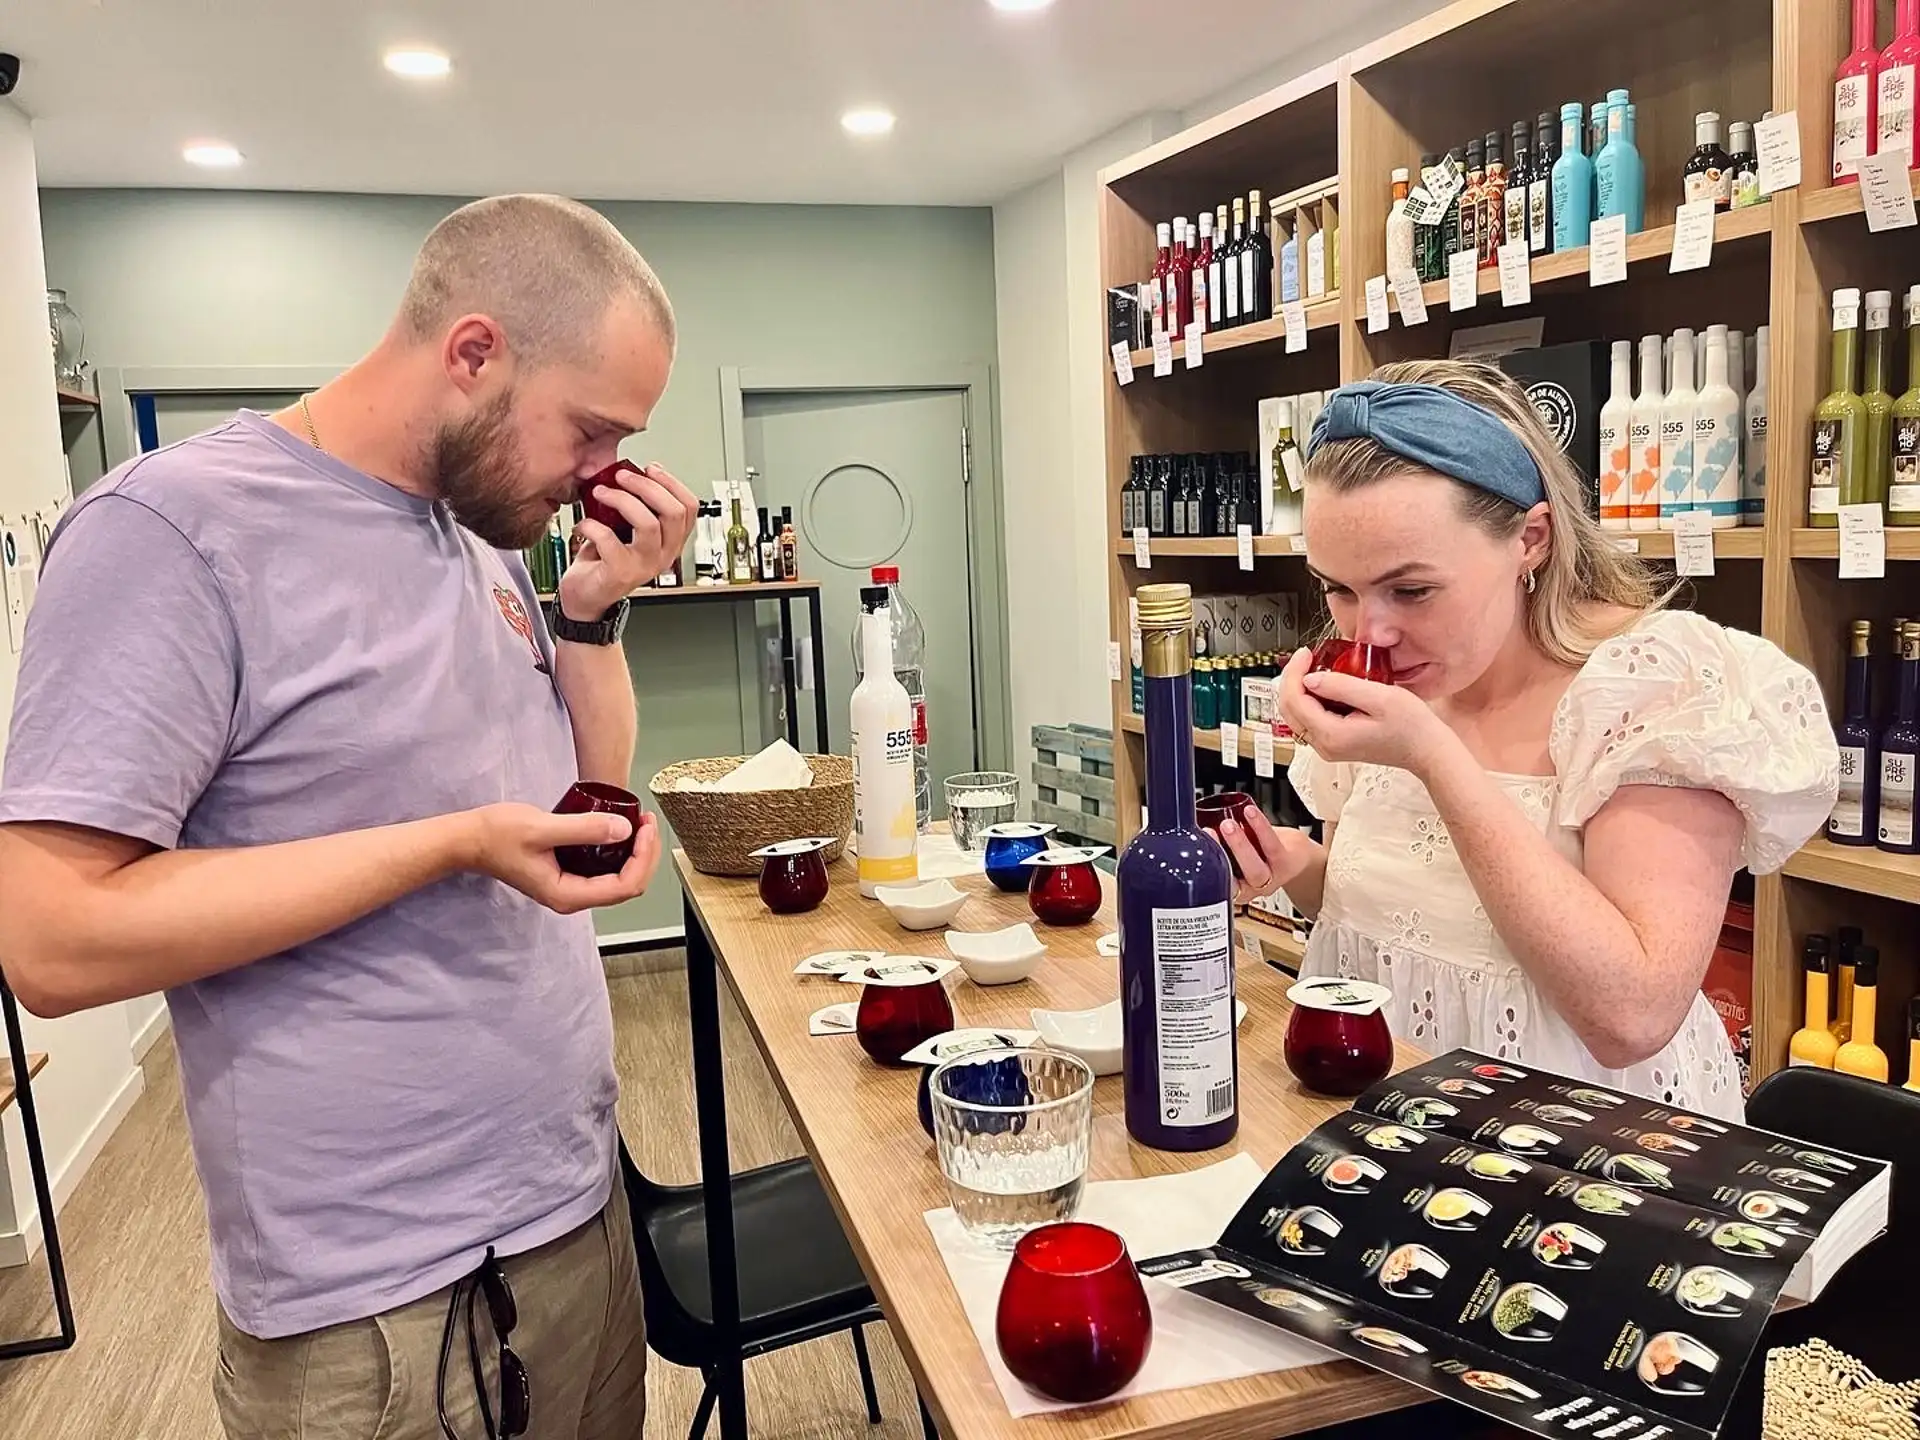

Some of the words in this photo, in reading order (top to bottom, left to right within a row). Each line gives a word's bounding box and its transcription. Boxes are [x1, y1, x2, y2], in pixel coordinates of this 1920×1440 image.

[1886, 75, 1901, 85] SU
[1840, 82, 1856, 92] SU
[1883, 81, 1905, 92] PRE
[1838, 89, 1859, 102] PRE
[1885, 91, 1902, 102] MO
[1840, 99, 1856, 110] MO
[1662, 422, 1684, 434] 555
[886, 728, 912, 748] 555
[1888, 758, 1903, 768] SU
[1884, 766, 1906, 776] PRE
[1886, 774, 1903, 782] MO
